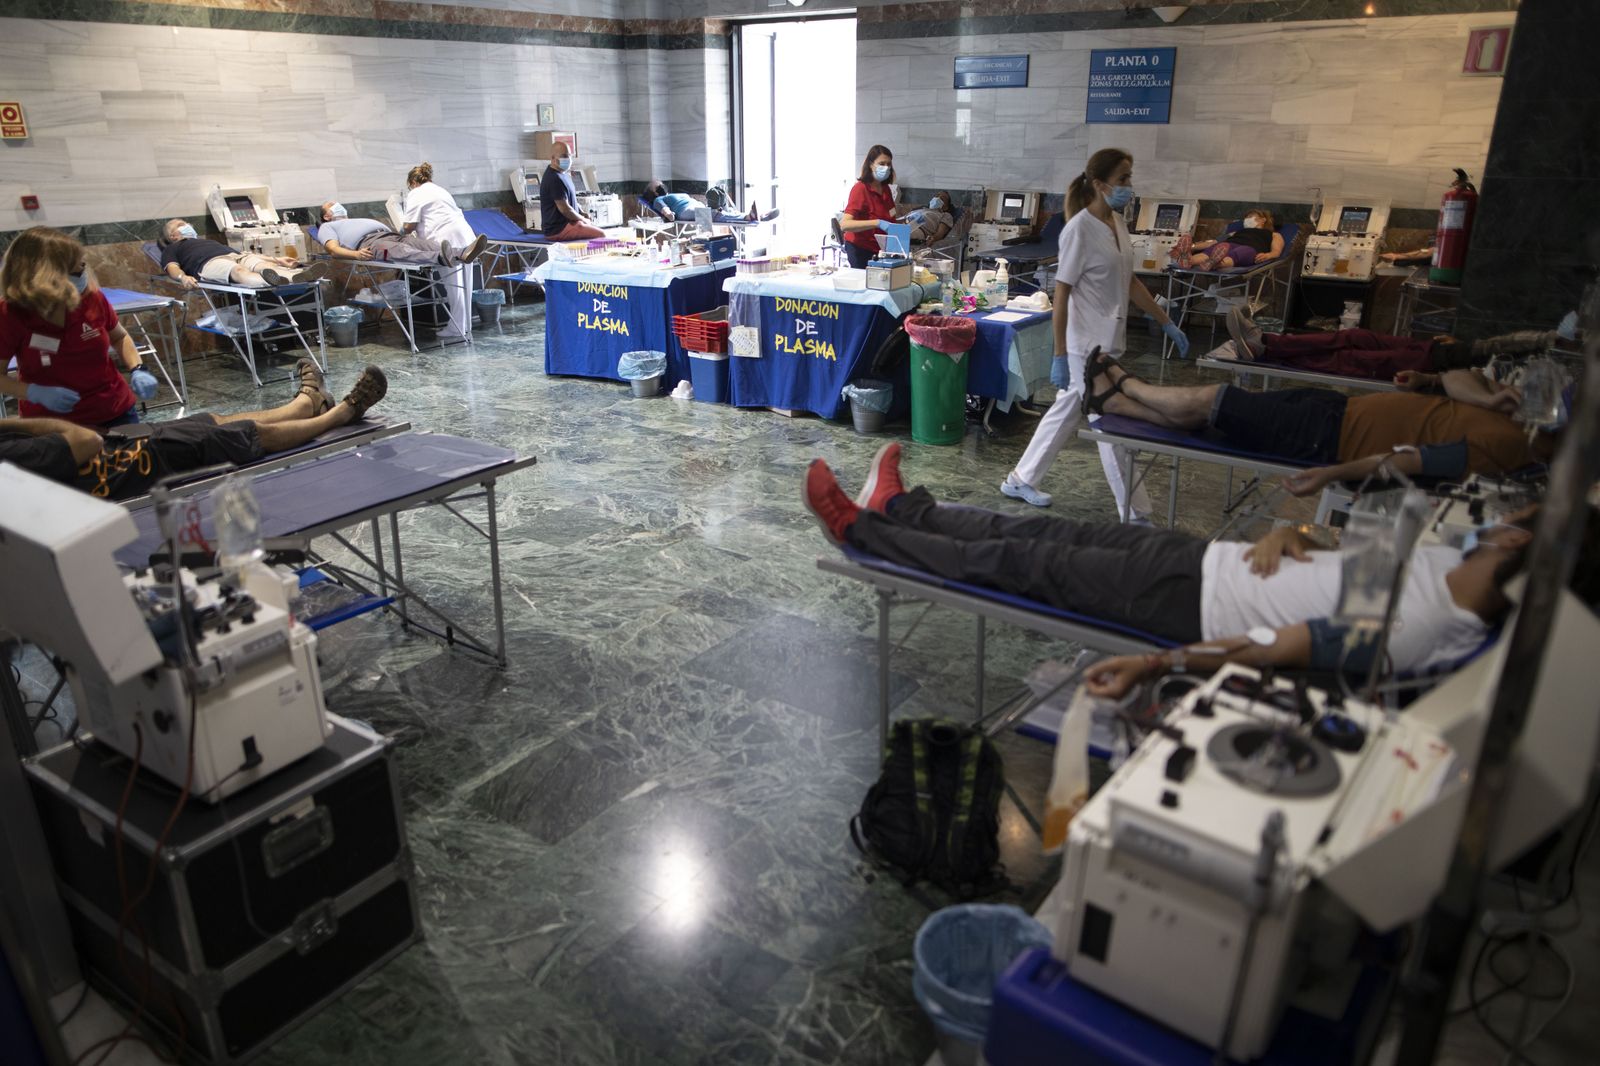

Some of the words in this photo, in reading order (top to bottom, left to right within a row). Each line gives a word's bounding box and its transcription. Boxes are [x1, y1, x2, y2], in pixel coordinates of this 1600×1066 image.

[1105, 56, 1147, 66] PLANTA
[1152, 55, 1159, 65] 0
[1104, 107, 1150, 115] SALIDA-EXIT
[593, 298, 611, 313] DE
[578, 312, 629, 336] PLASMA
[795, 318, 818, 334] DE
[775, 334, 836, 361] PLASMA
